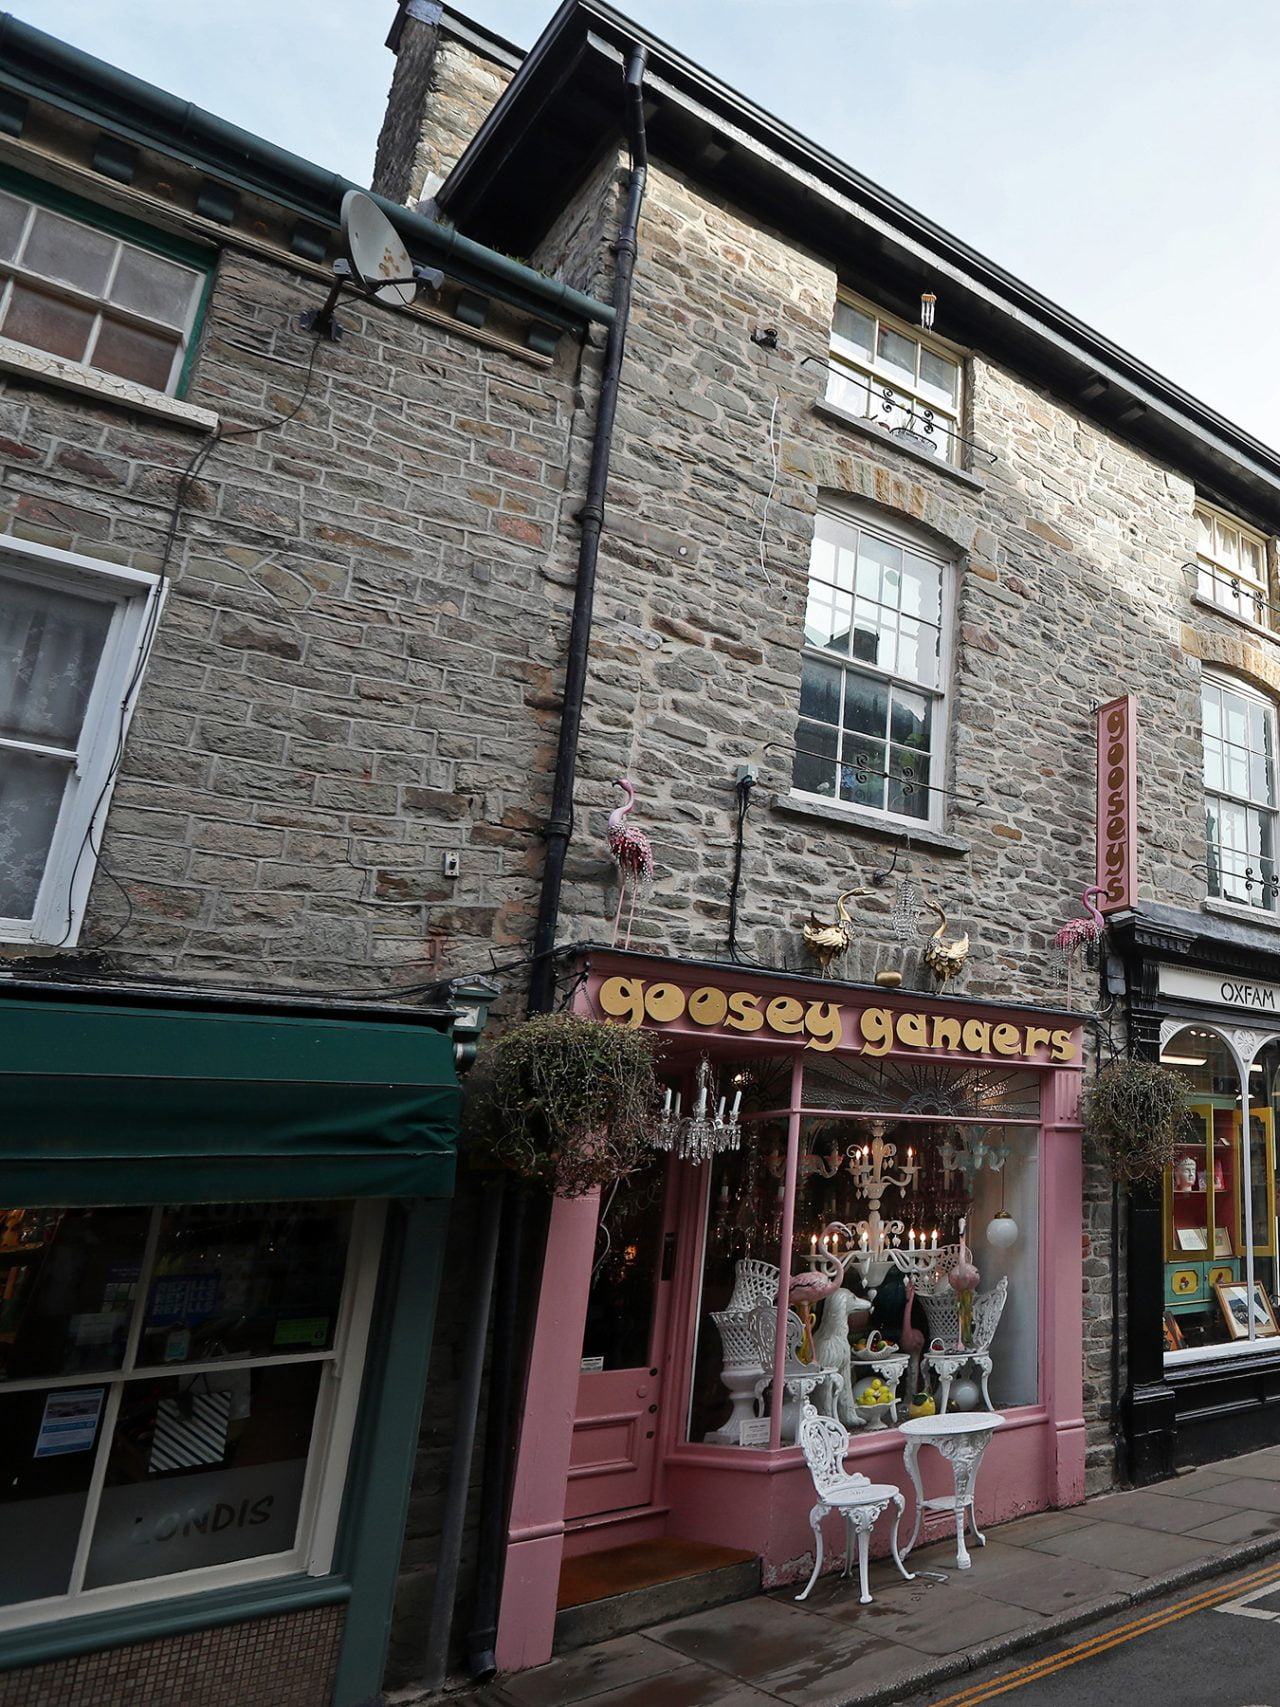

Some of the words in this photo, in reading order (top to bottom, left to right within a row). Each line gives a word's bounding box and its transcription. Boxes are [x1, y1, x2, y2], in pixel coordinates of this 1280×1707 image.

[1105, 708, 1127, 904] gooseys
[599, 976, 844, 1053] goosey
[860, 1007, 1077, 1061] ganders
[1221, 982, 1275, 1009] OXFAM
